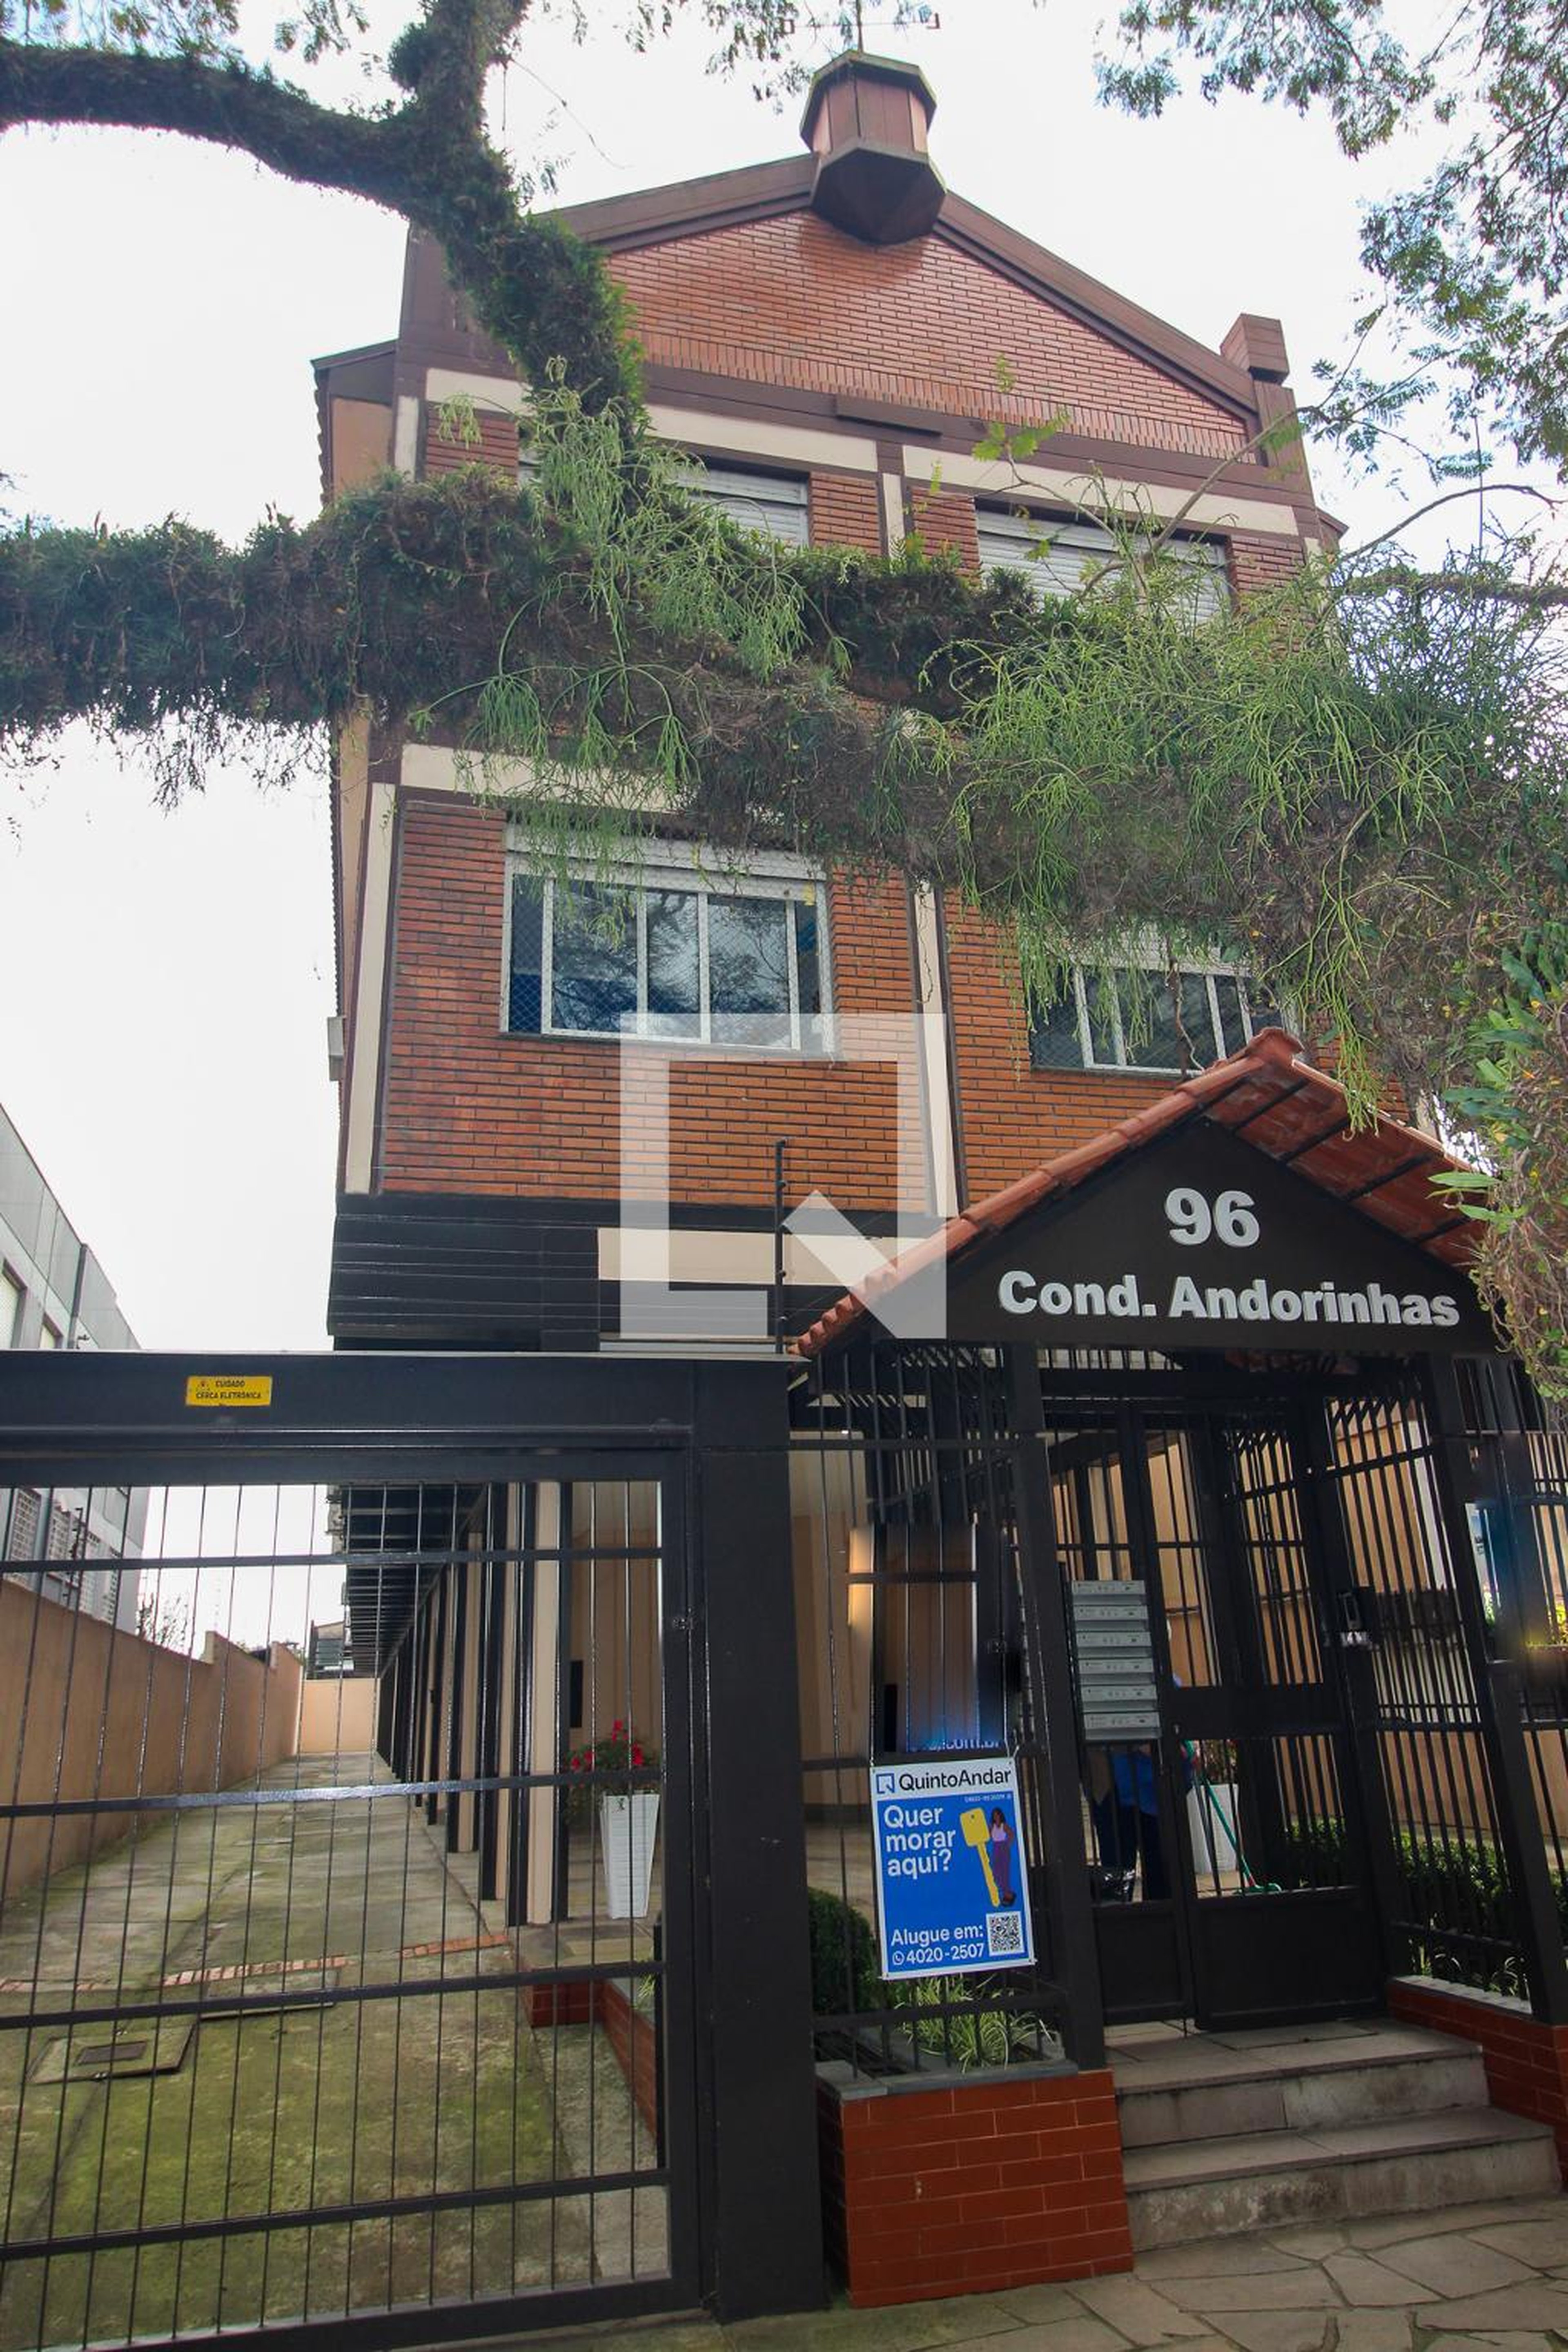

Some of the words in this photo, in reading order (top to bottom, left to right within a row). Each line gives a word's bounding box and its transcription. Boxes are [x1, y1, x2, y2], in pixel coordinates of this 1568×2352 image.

[1165, 1187, 1260, 1247] 96
[998, 1270, 1156, 1316] Cond.
[1168, 1276, 1460, 1325] Andorinhas
[899, 1769, 1011, 1791] QuintoAndar
[884, 1805, 943, 1828] Quer
[886, 1830, 956, 1852] morar
[888, 1849, 951, 1880] aqui?
[891, 1929, 950, 1947] Alugue
[953, 1924, 984, 1940] em:
[906, 1943, 984, 1964] 4020-2507
